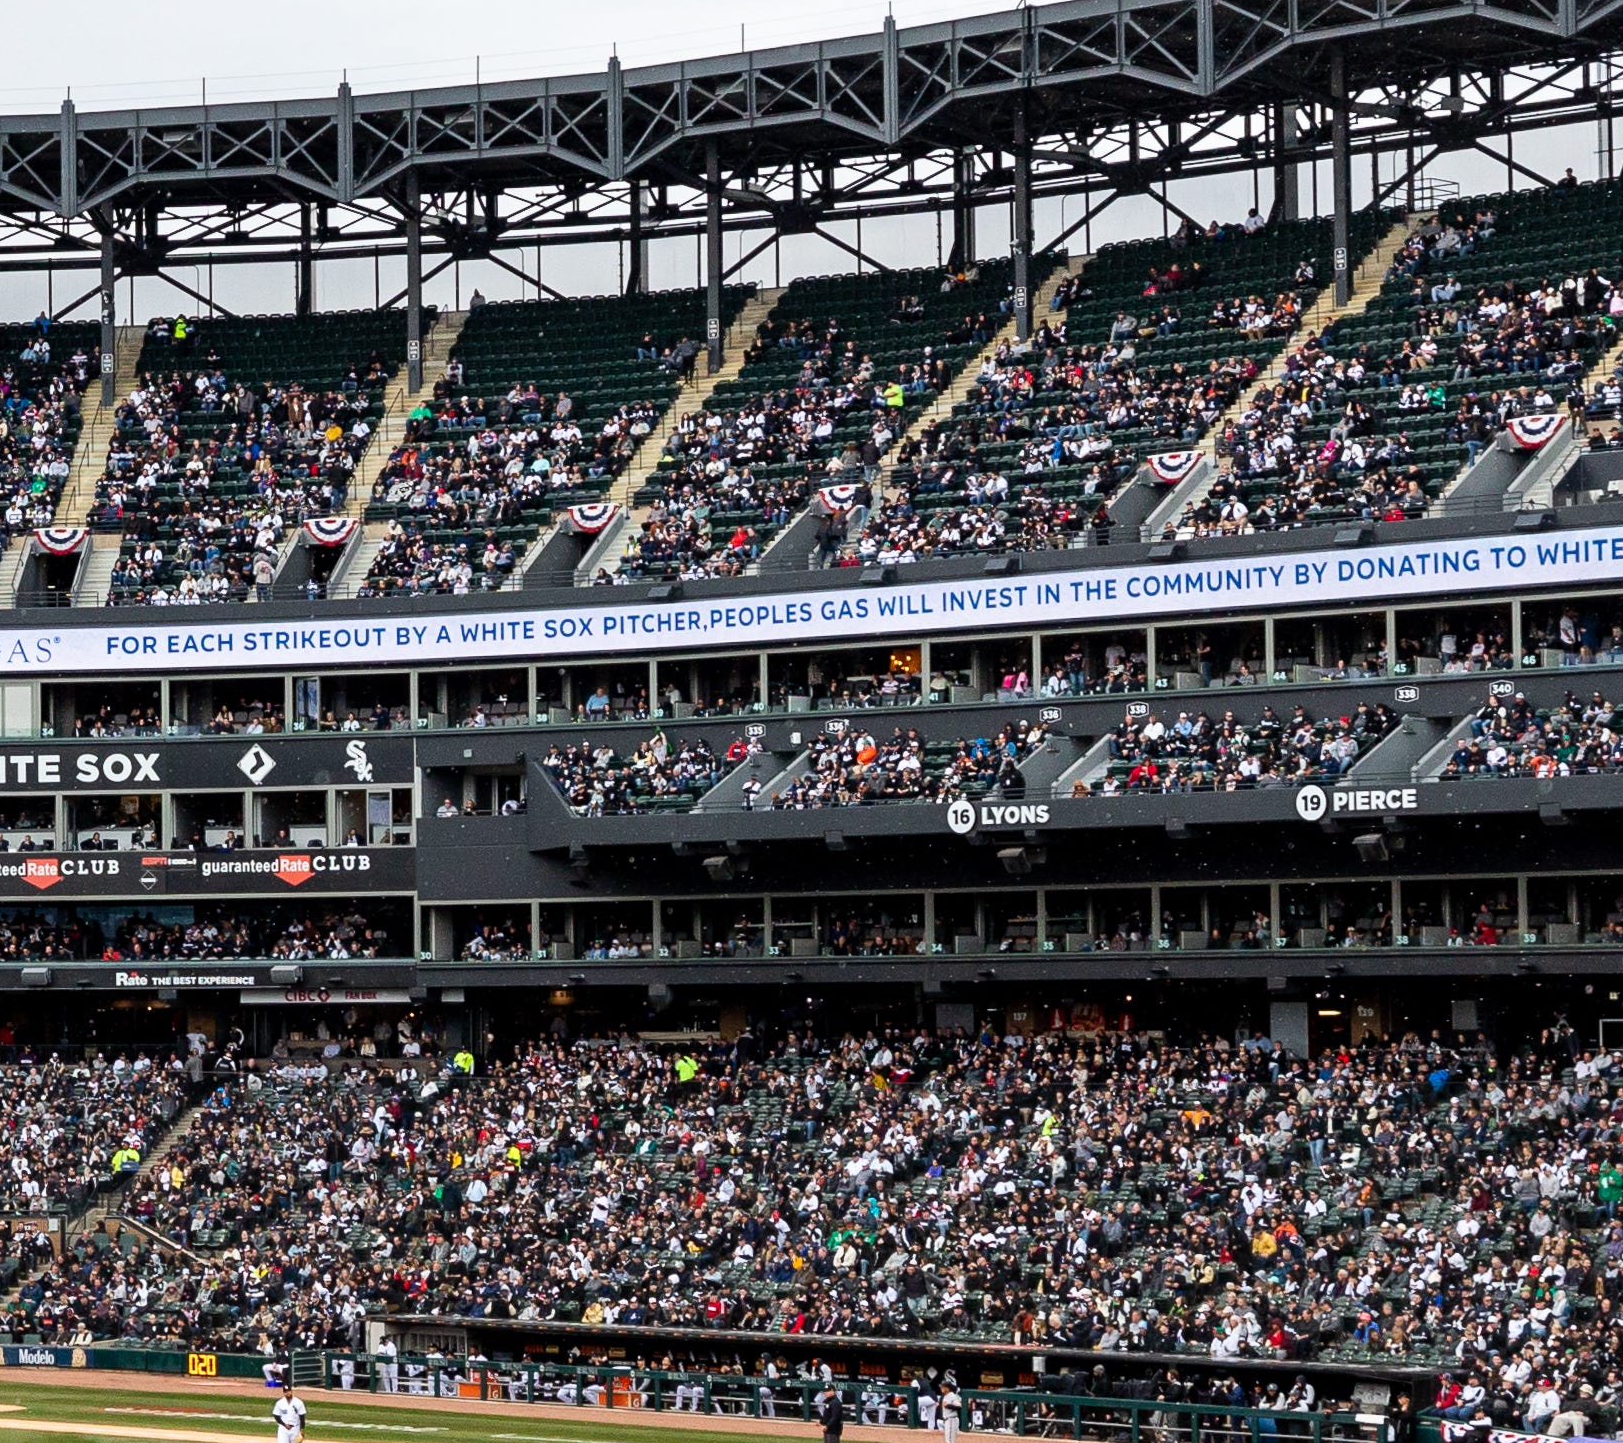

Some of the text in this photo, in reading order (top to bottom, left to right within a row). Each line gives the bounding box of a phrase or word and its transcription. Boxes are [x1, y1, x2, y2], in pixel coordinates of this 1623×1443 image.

[106, 635, 157, 655] FOR
[167, 633, 233, 654] EACH
[243, 627, 387, 652] STRIKEOUT
[396, 625, 428, 646] BY
[435, 625, 452, 644] A
[460, 620, 535, 643] WHITE
[544, 617, 593, 639] SOX
[820, 598, 869, 621] GAS
[876, 593, 934, 617] WILL
[942, 585, 1028, 613] INVEST
[1036, 582, 1061, 605] IN
[1069, 578, 1118, 603] THE
[1126, 565, 1285, 598] COMMUNITY
[1294, 561, 1328, 586] BY
[1337, 549, 1480, 582] DONATING
[1489, 545, 1527, 570] TO
[1398, 690, 1416, 699] 338
[1492, 685, 1512, 694] 340
[1043, 711, 1059, 720] 336
[1129, 705, 1146, 714] 338
[76, 754, 160, 784] SOX
[1302, 789, 1417, 812] 19 PIERCE
[952, 804, 1050, 824] 16 LYONS
[28, 863, 57, 876] Rate
[59, 860, 119, 880] CLUB
[202, 859, 279, 876] guaranteed
[281, 859, 309, 872] Rate
[313, 855, 370, 870] CLUB
[116, 972, 254, 989] Rate THE BEST EXPERIENCE
[285, 991, 314, 1003] CIBC
[19, 1349, 55, 1364] Modelo
